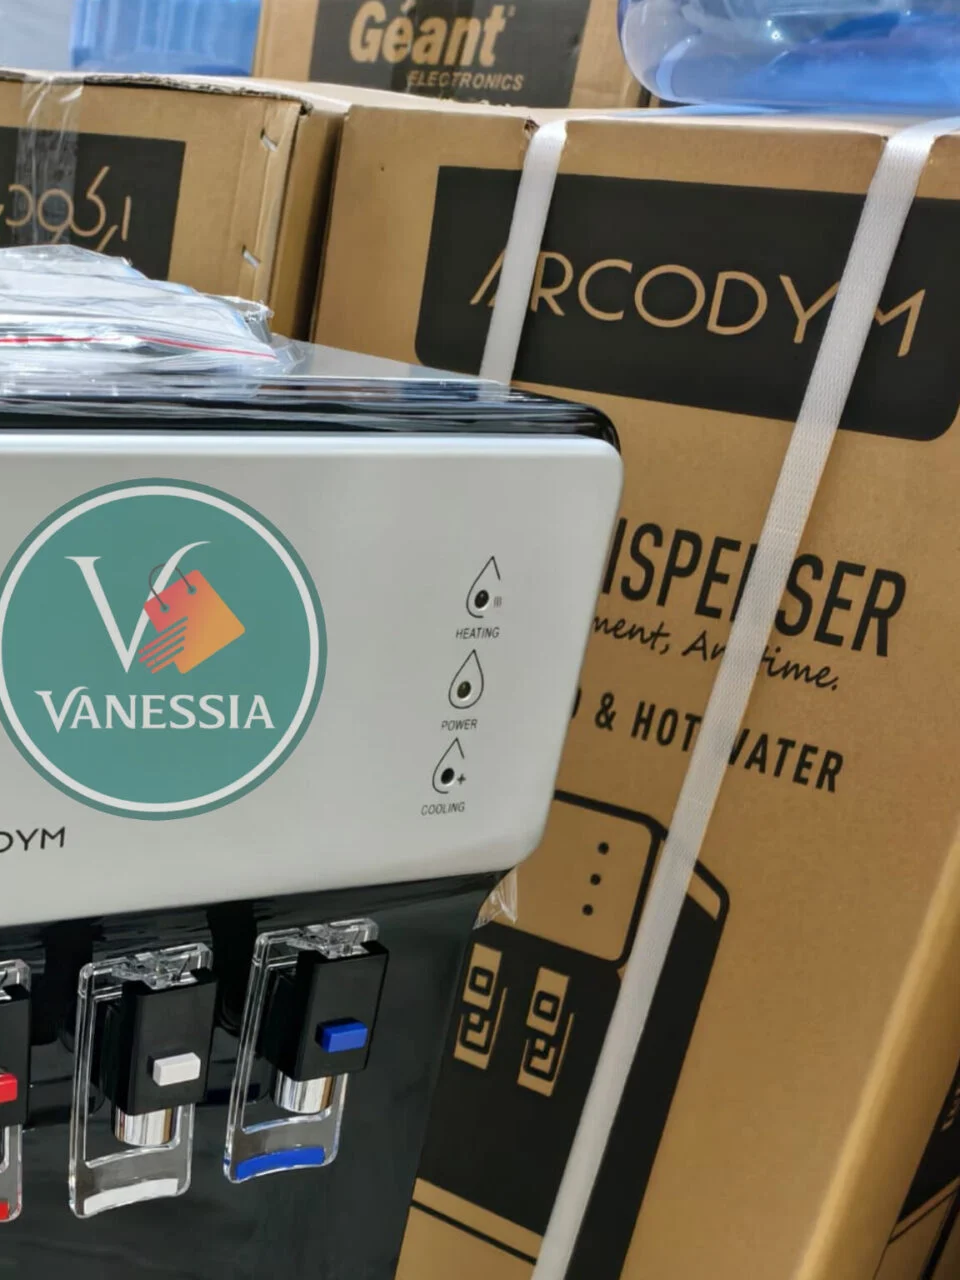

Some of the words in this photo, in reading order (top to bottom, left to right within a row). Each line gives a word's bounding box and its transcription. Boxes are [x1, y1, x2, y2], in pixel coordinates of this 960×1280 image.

[349, 0, 507, 67] Géant
[408, 70, 525, 92] ELECTRONICS
[601, 517, 907, 658] ISPESER
[455, 626, 500, 640] HEATING
[593, 615, 671, 655] ment,
[441, 719, 478, 731] POWER
[594, 692, 617, 732] &
[631, 701, 703, 752] HOT
[421, 802, 466, 816] COOLING
